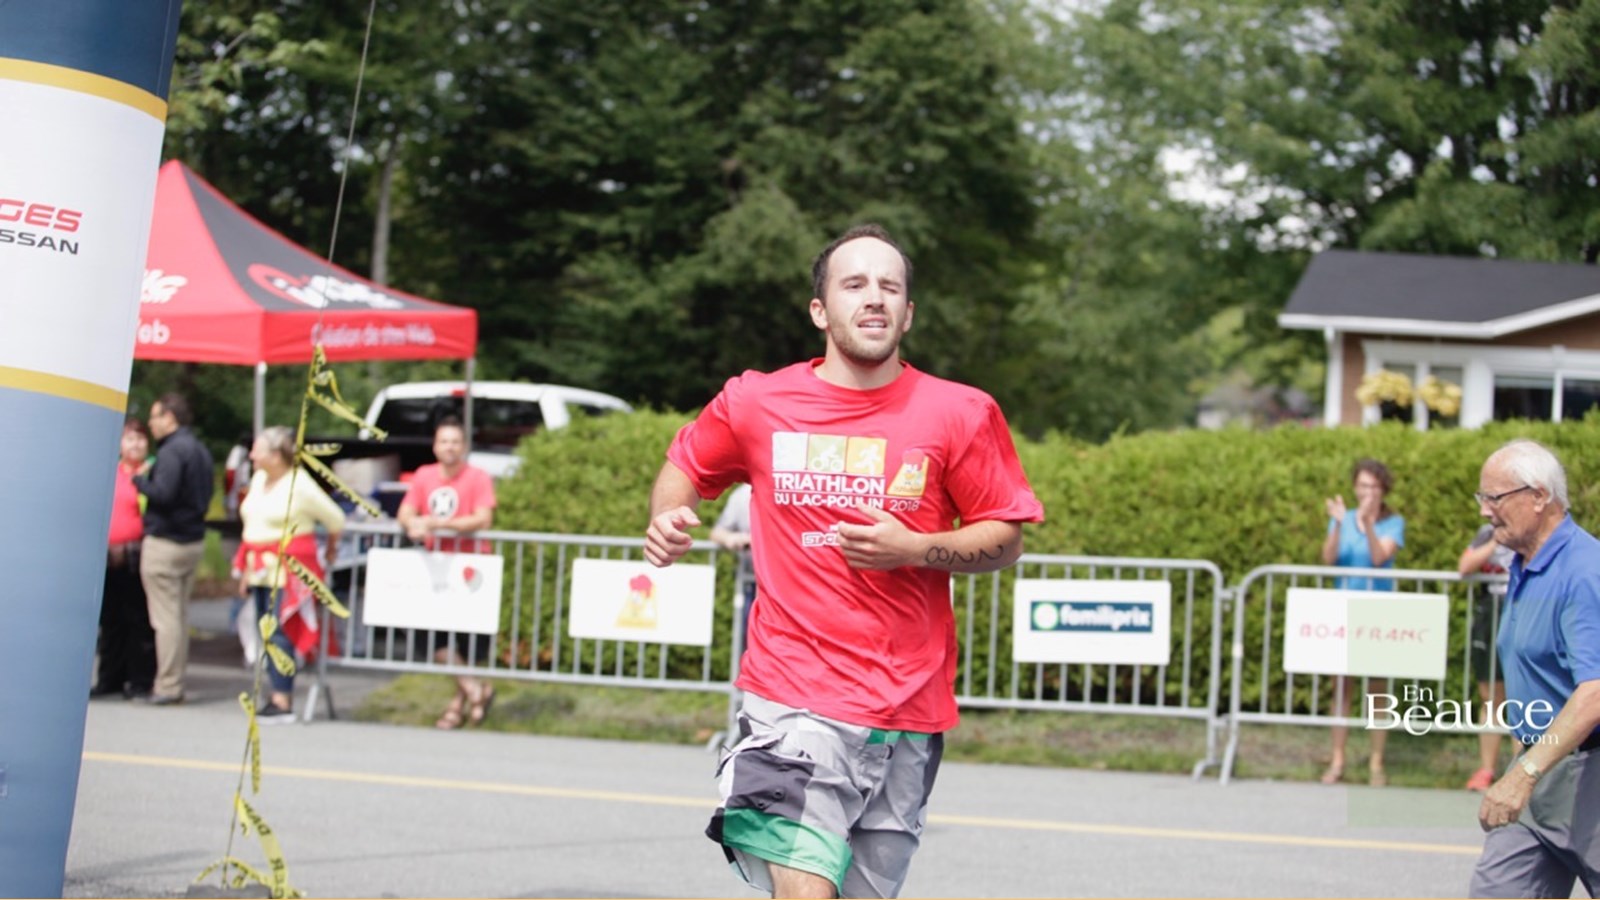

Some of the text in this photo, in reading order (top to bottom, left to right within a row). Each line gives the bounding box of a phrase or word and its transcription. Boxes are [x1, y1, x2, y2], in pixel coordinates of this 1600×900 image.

[772, 472, 885, 495] TRIATHLON
[774, 493, 790, 506] DU
[889, 499, 921, 512] 2018
